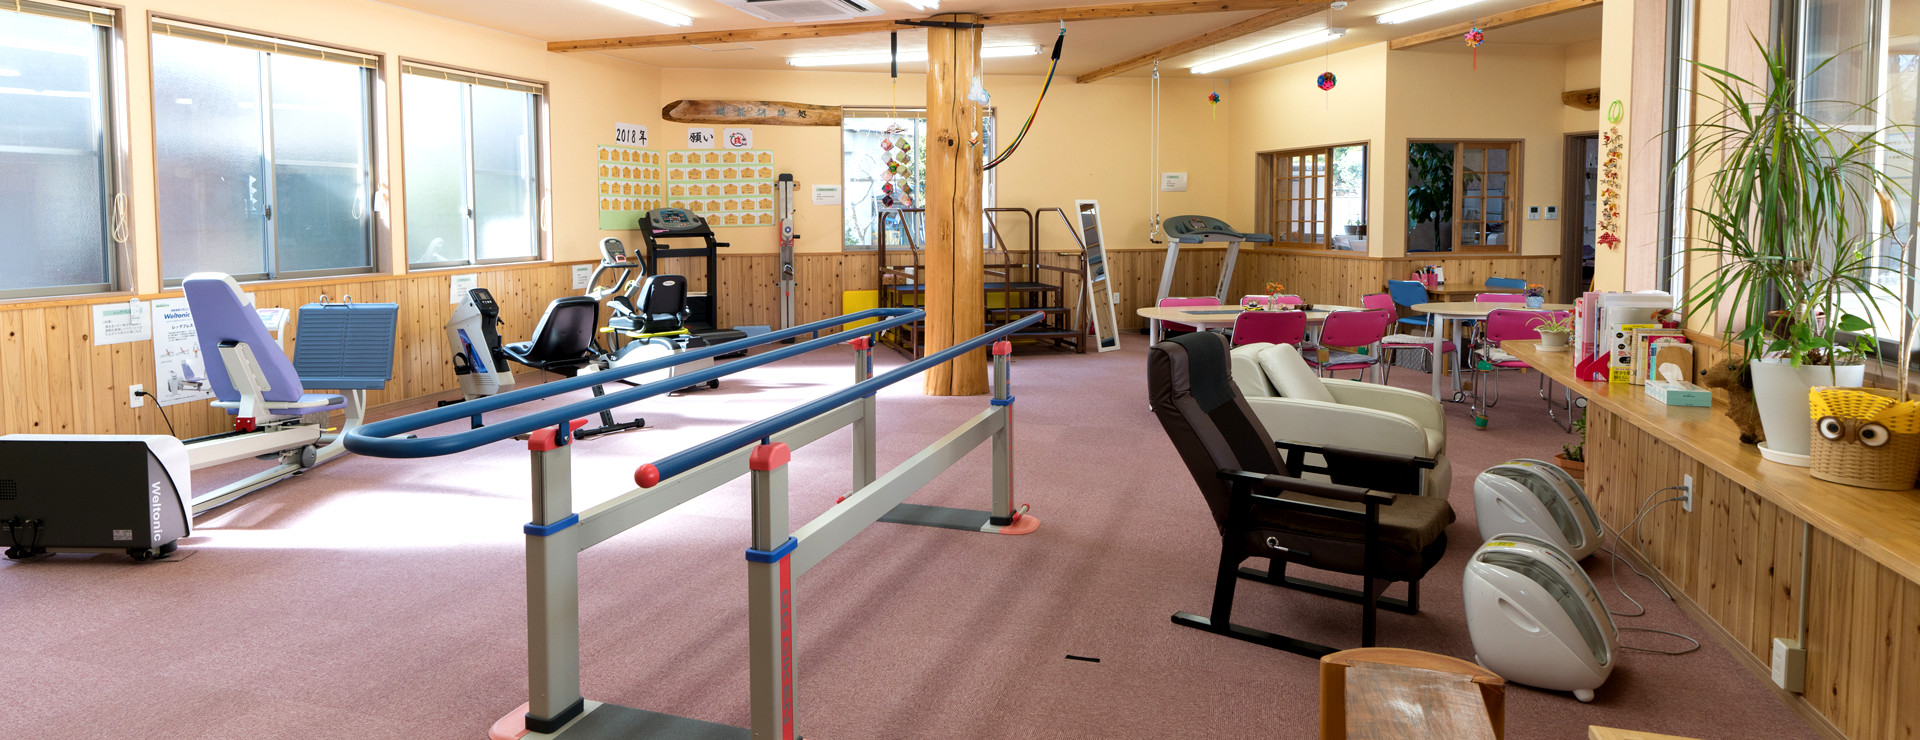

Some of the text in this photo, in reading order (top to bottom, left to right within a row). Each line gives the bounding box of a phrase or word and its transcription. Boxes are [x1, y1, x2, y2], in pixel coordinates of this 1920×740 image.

[615, 128, 648, 146] 2018年
[689, 131, 714, 144] 願い
[164, 312, 190, 320] Weltonic
[151, 481, 163, 542] Weltonic
[782, 636, 791, 726] GIKEN
